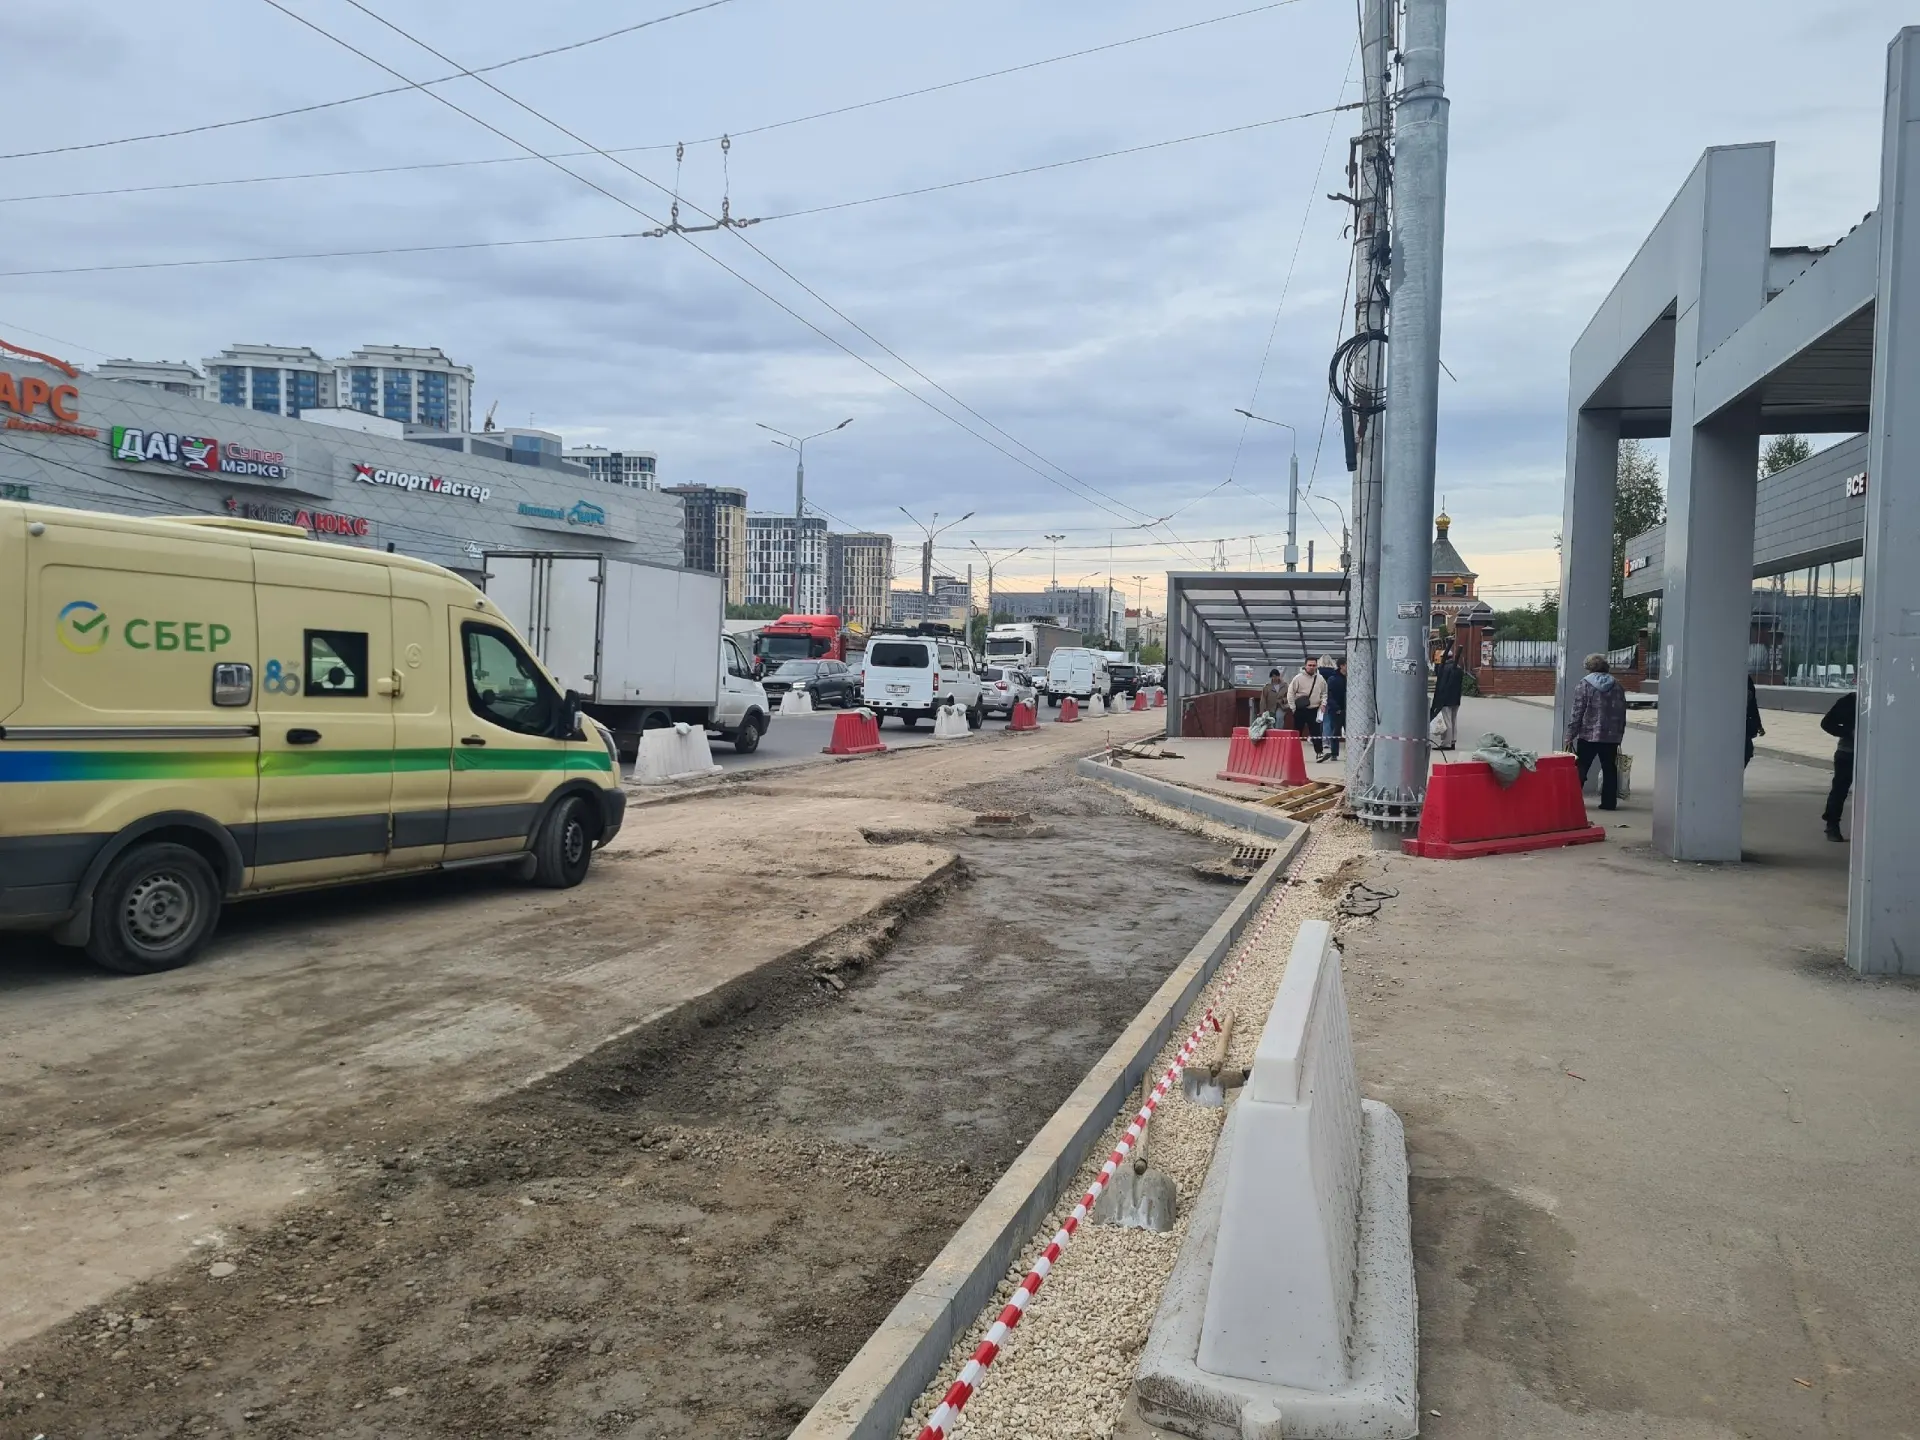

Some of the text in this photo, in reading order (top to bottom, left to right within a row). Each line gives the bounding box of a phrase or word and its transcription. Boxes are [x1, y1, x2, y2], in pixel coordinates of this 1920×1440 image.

[117, 427, 179, 462] ДА!
[226, 442, 284, 464] Супер
[124, 619, 231, 652] СБЕР
